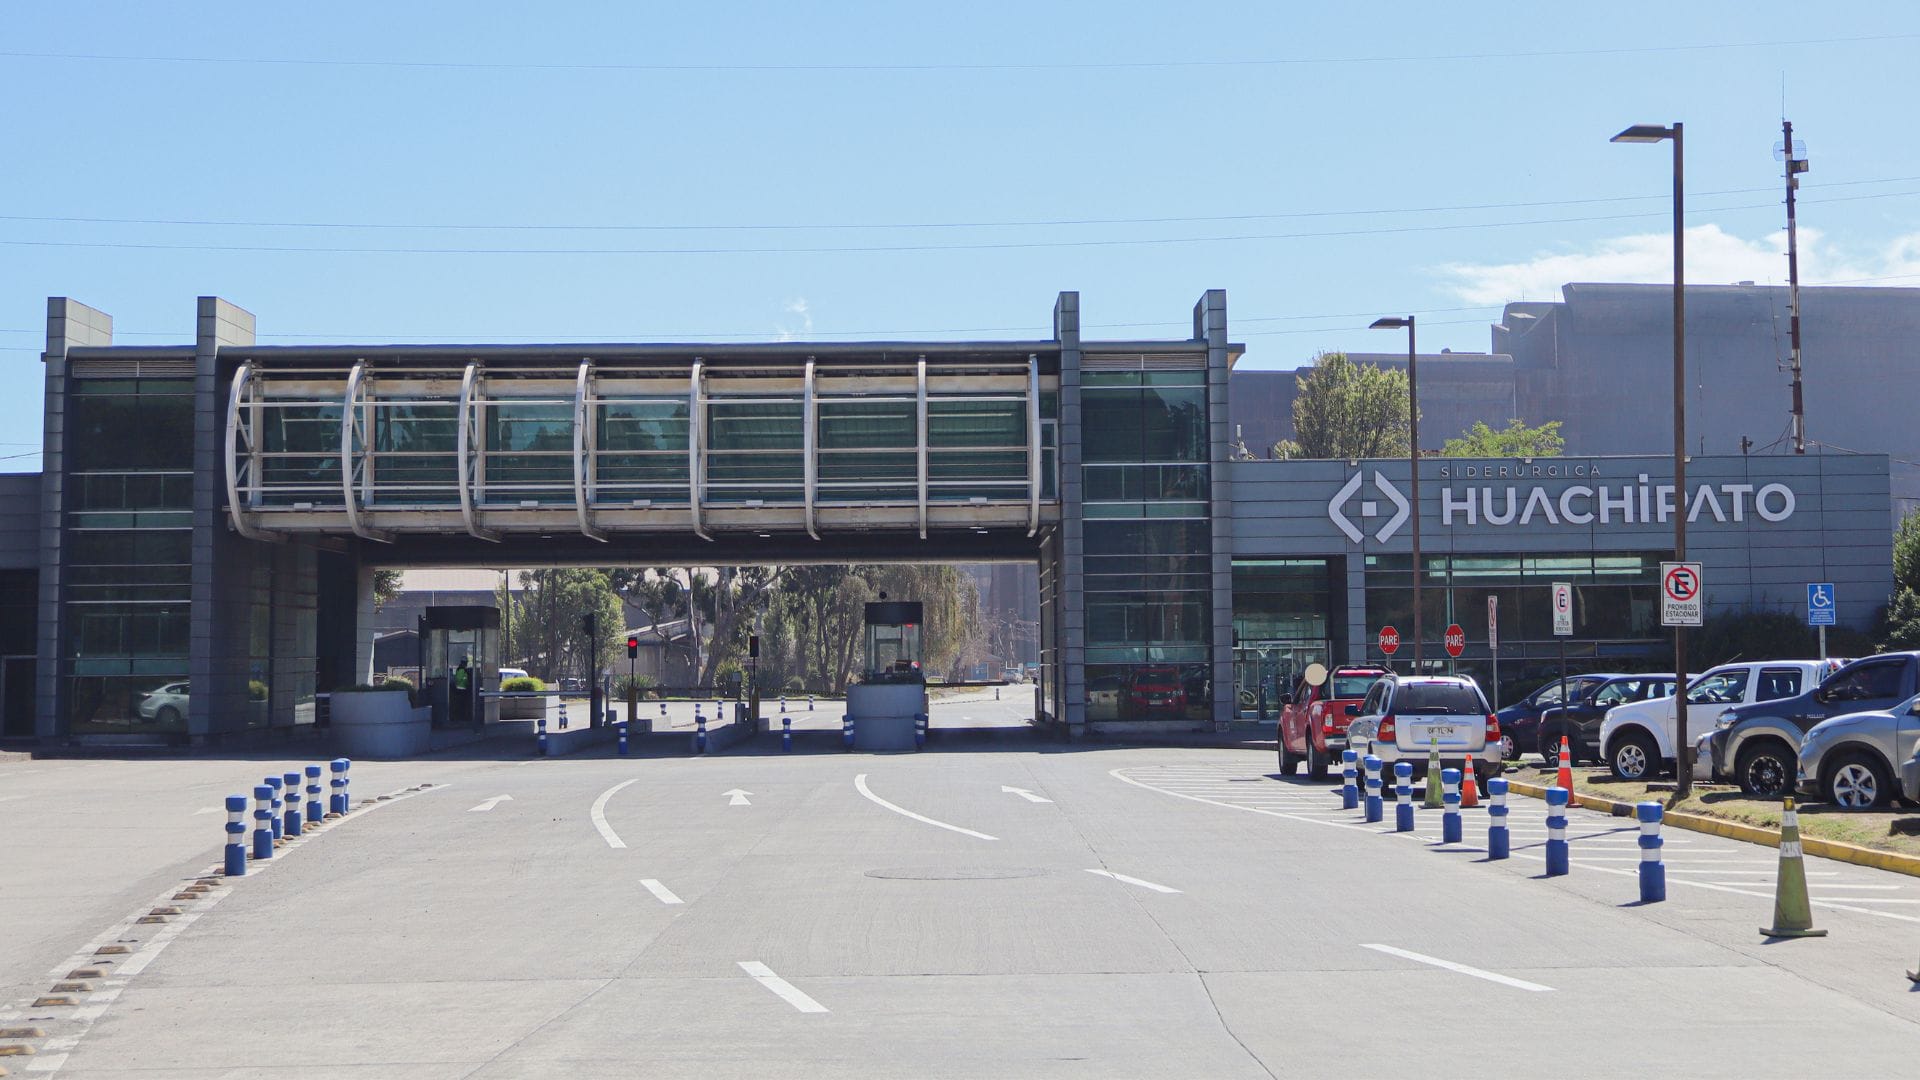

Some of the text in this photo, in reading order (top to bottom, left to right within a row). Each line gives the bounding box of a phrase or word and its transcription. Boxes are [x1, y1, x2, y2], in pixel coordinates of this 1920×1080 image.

[1441, 464, 1601, 477] SIDERÚRGICA
[1665, 610, 1699, 618] ESTACIONAR
[1380, 635, 1398, 646] PARE
[1445, 635, 1464, 647] PARE
